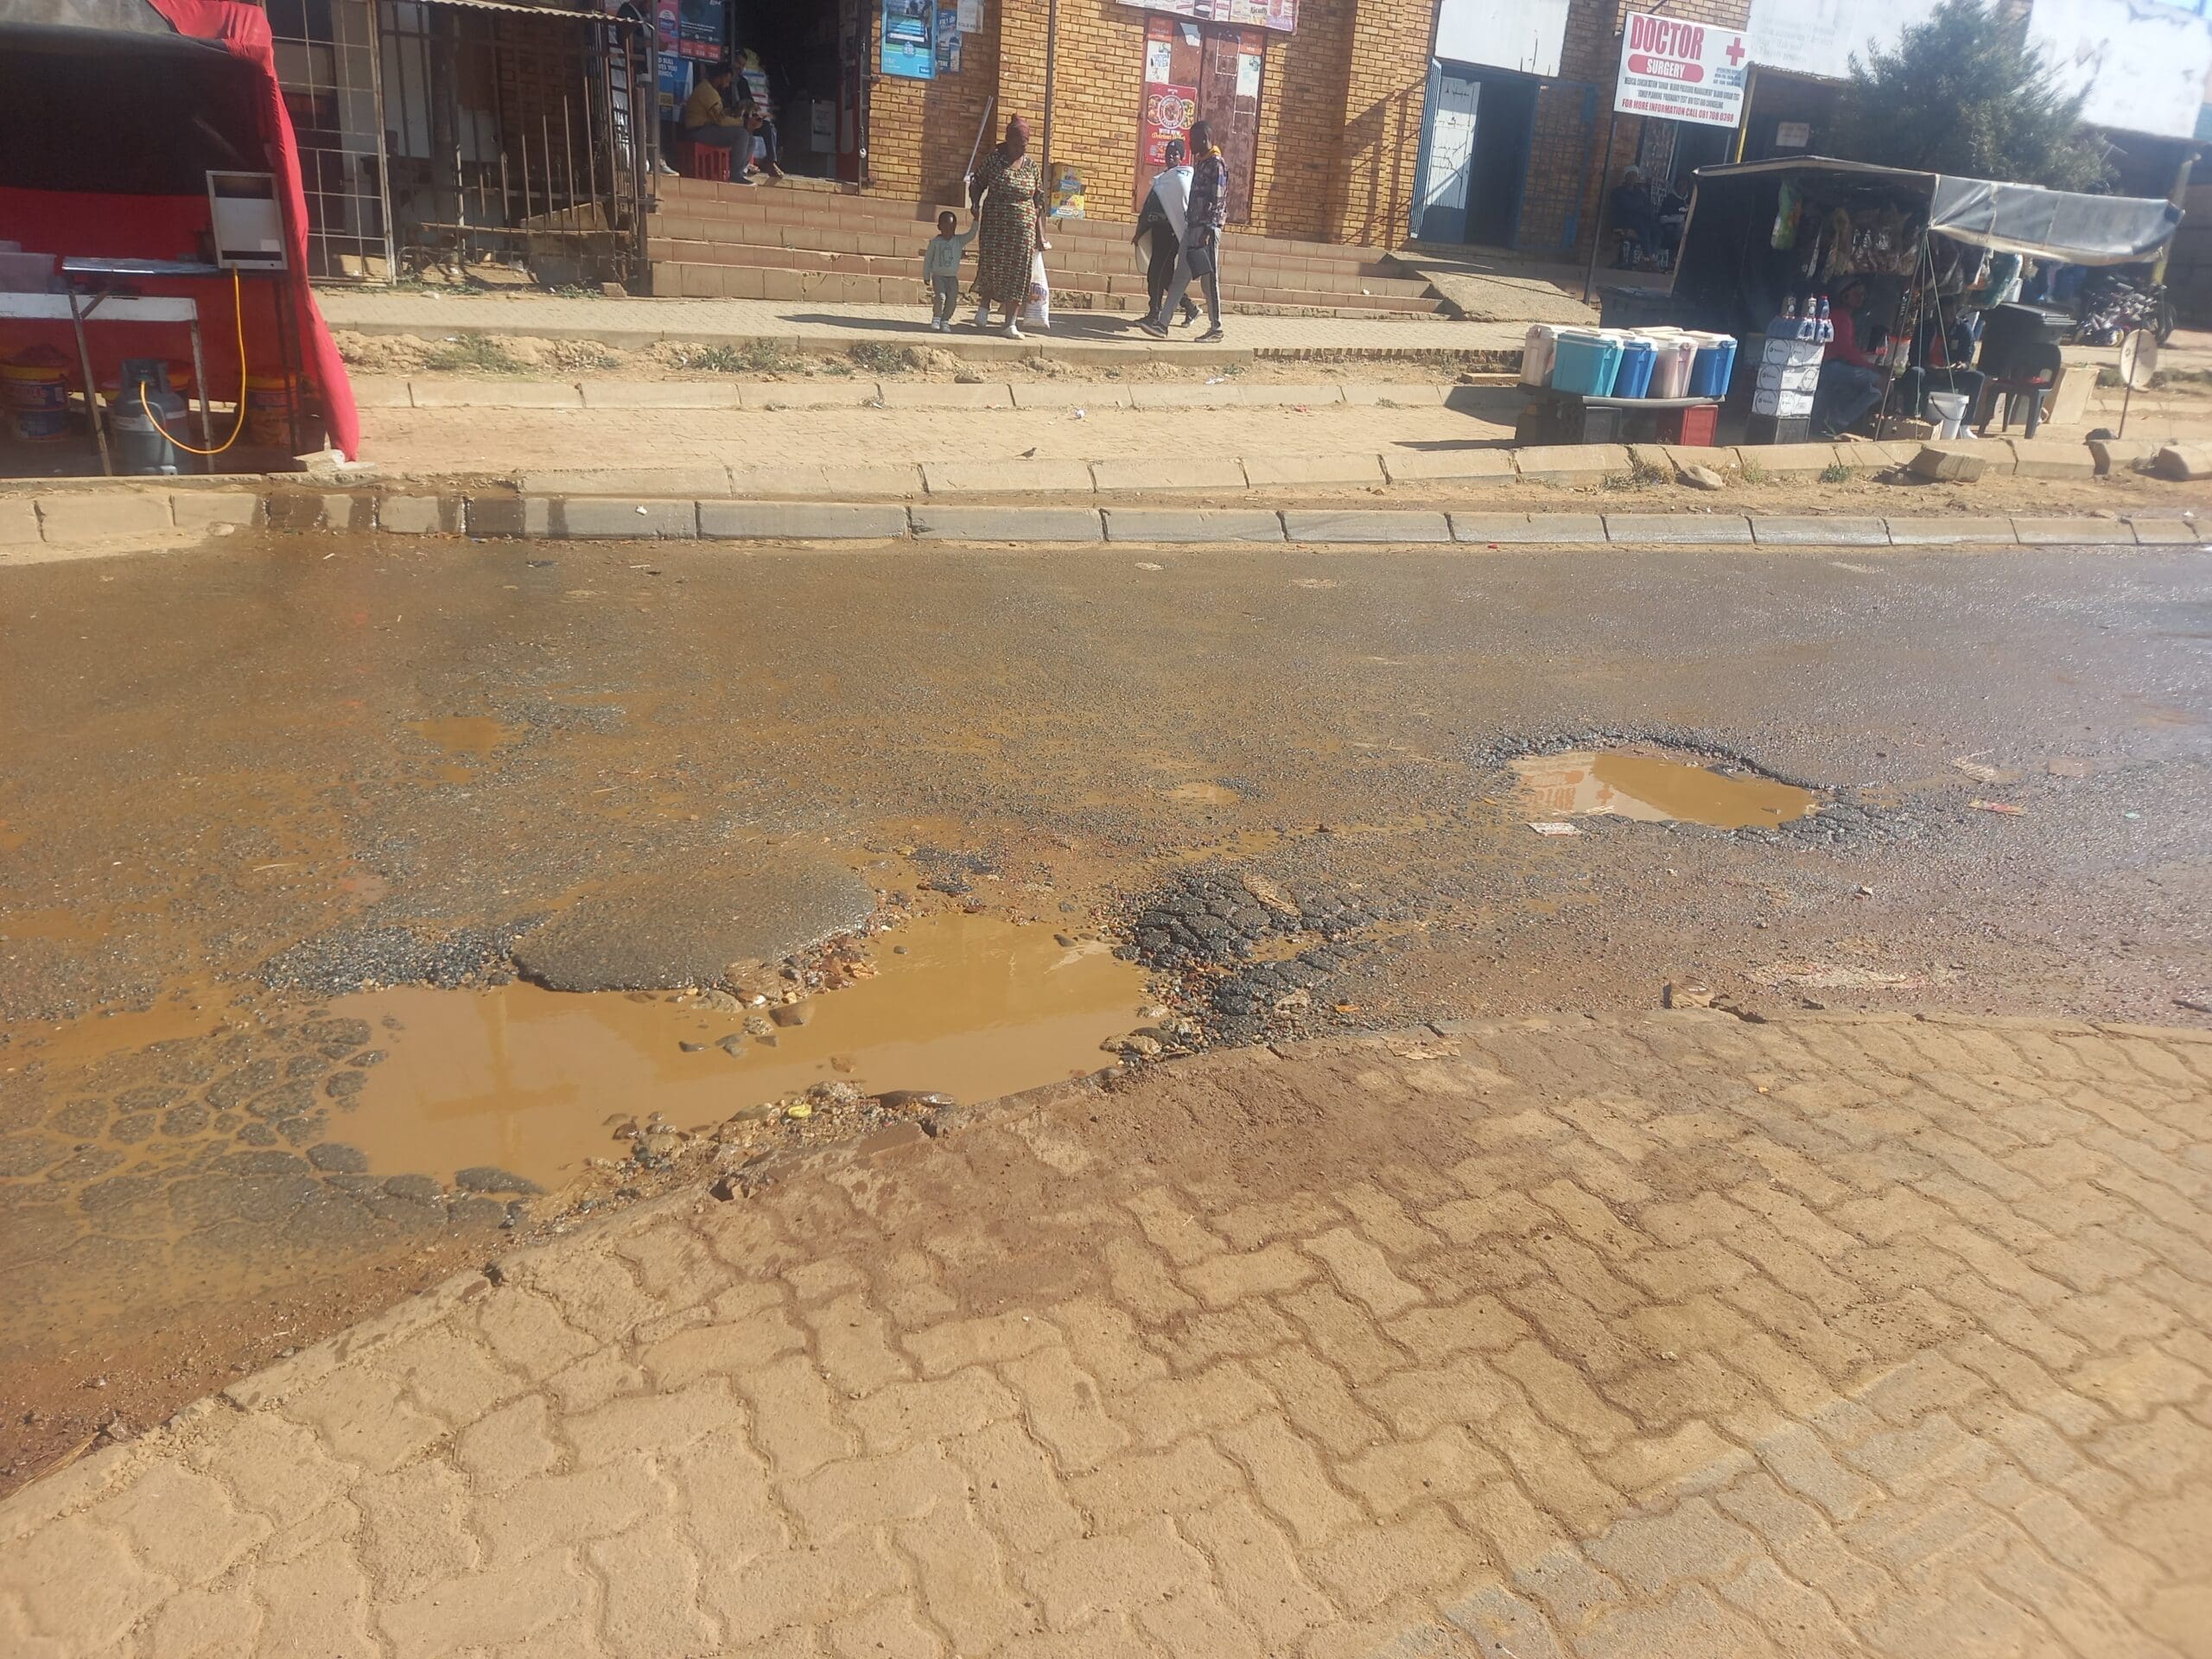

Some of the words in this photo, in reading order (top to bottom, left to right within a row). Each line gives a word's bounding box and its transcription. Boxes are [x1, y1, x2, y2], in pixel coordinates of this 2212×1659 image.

[1630, 15, 1705, 60] DOCTOR
[1646, 59, 1686, 79] SURGERY
[1622, 99, 1632, 108] FOR
[1633, 100, 1649, 111] MORE
[1649, 103, 1685, 116] INFORMATION
[1686, 108, 1698, 118] CALL
